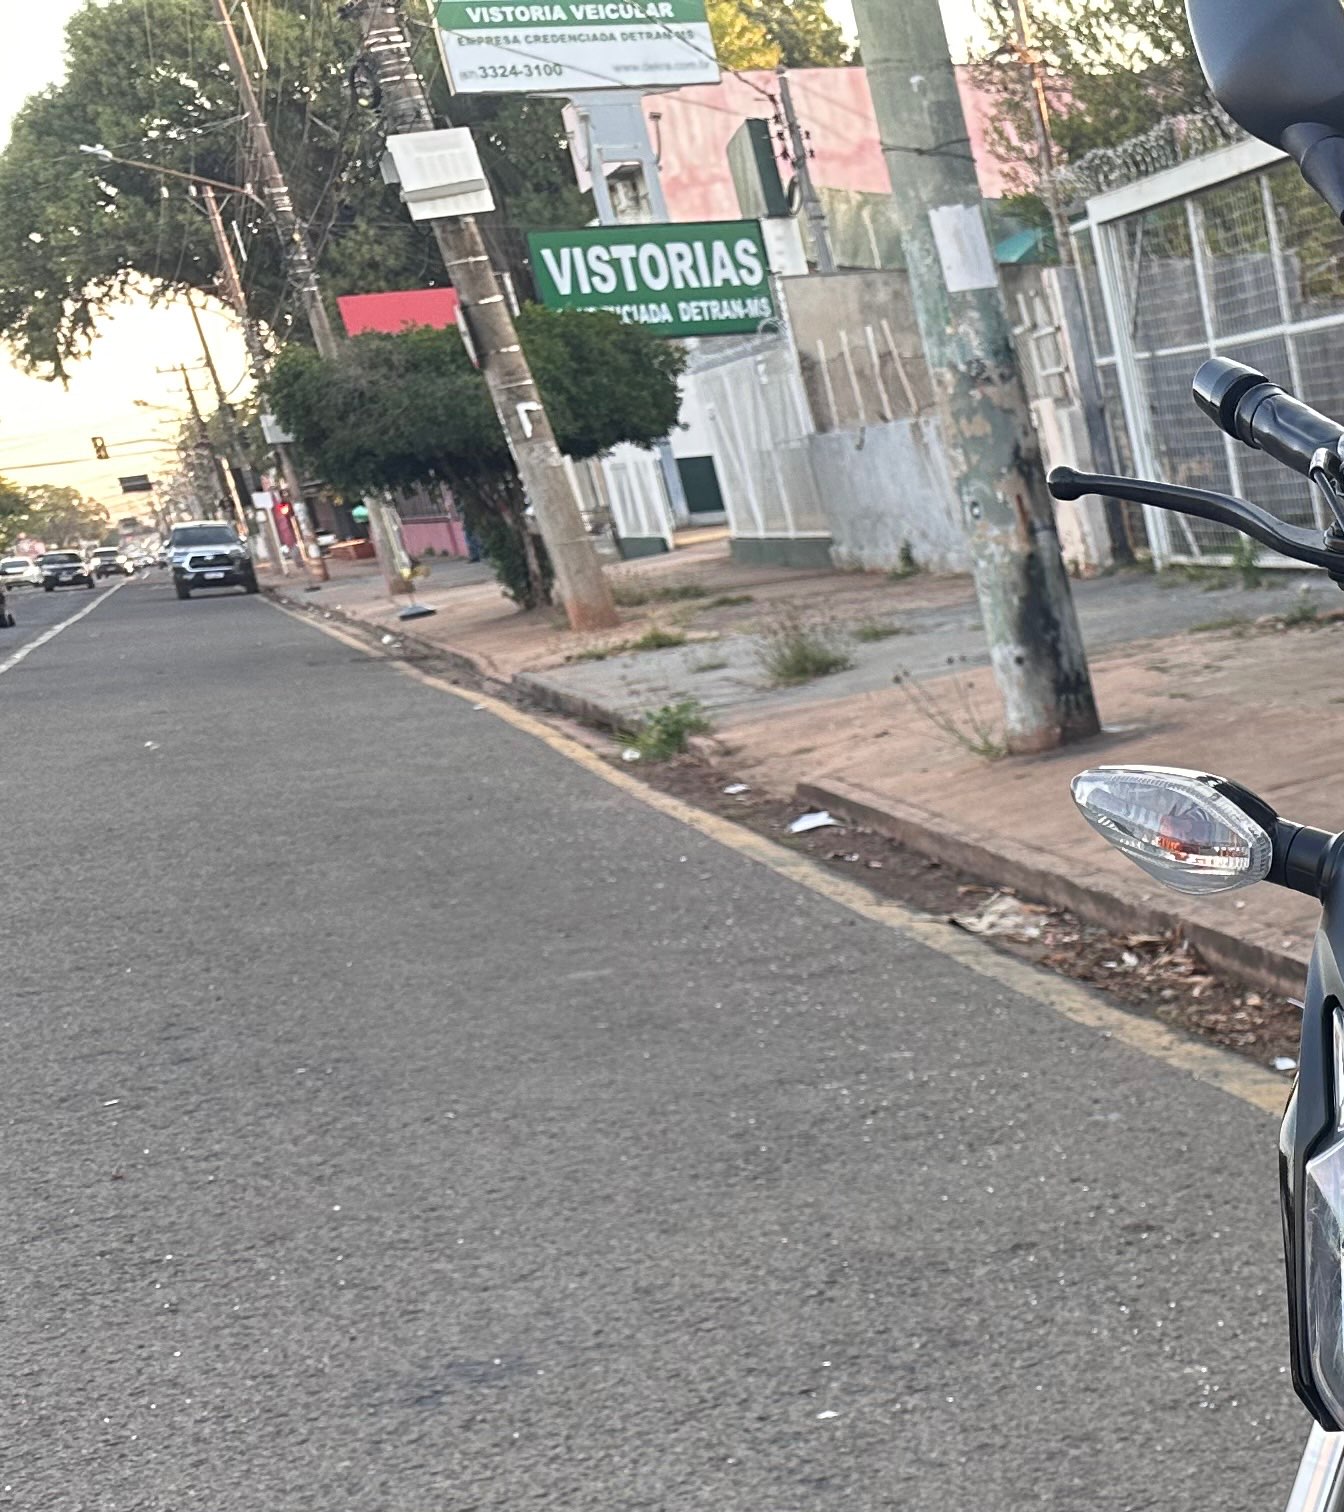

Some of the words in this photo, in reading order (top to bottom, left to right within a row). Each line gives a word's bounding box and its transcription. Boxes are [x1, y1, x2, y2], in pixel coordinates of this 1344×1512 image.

[465, 4, 567, 24] VISTORIA
[570, 1, 675, 21] VEICULAR
[457, 33, 521, 46] EMPRESA
[524, 30, 618, 45] CREDENCIADA
[478, 63, 564, 79] 3324-3100
[540, 238, 764, 296] VISTORIAS
[677, 296, 772, 323] DETRAN-MS
